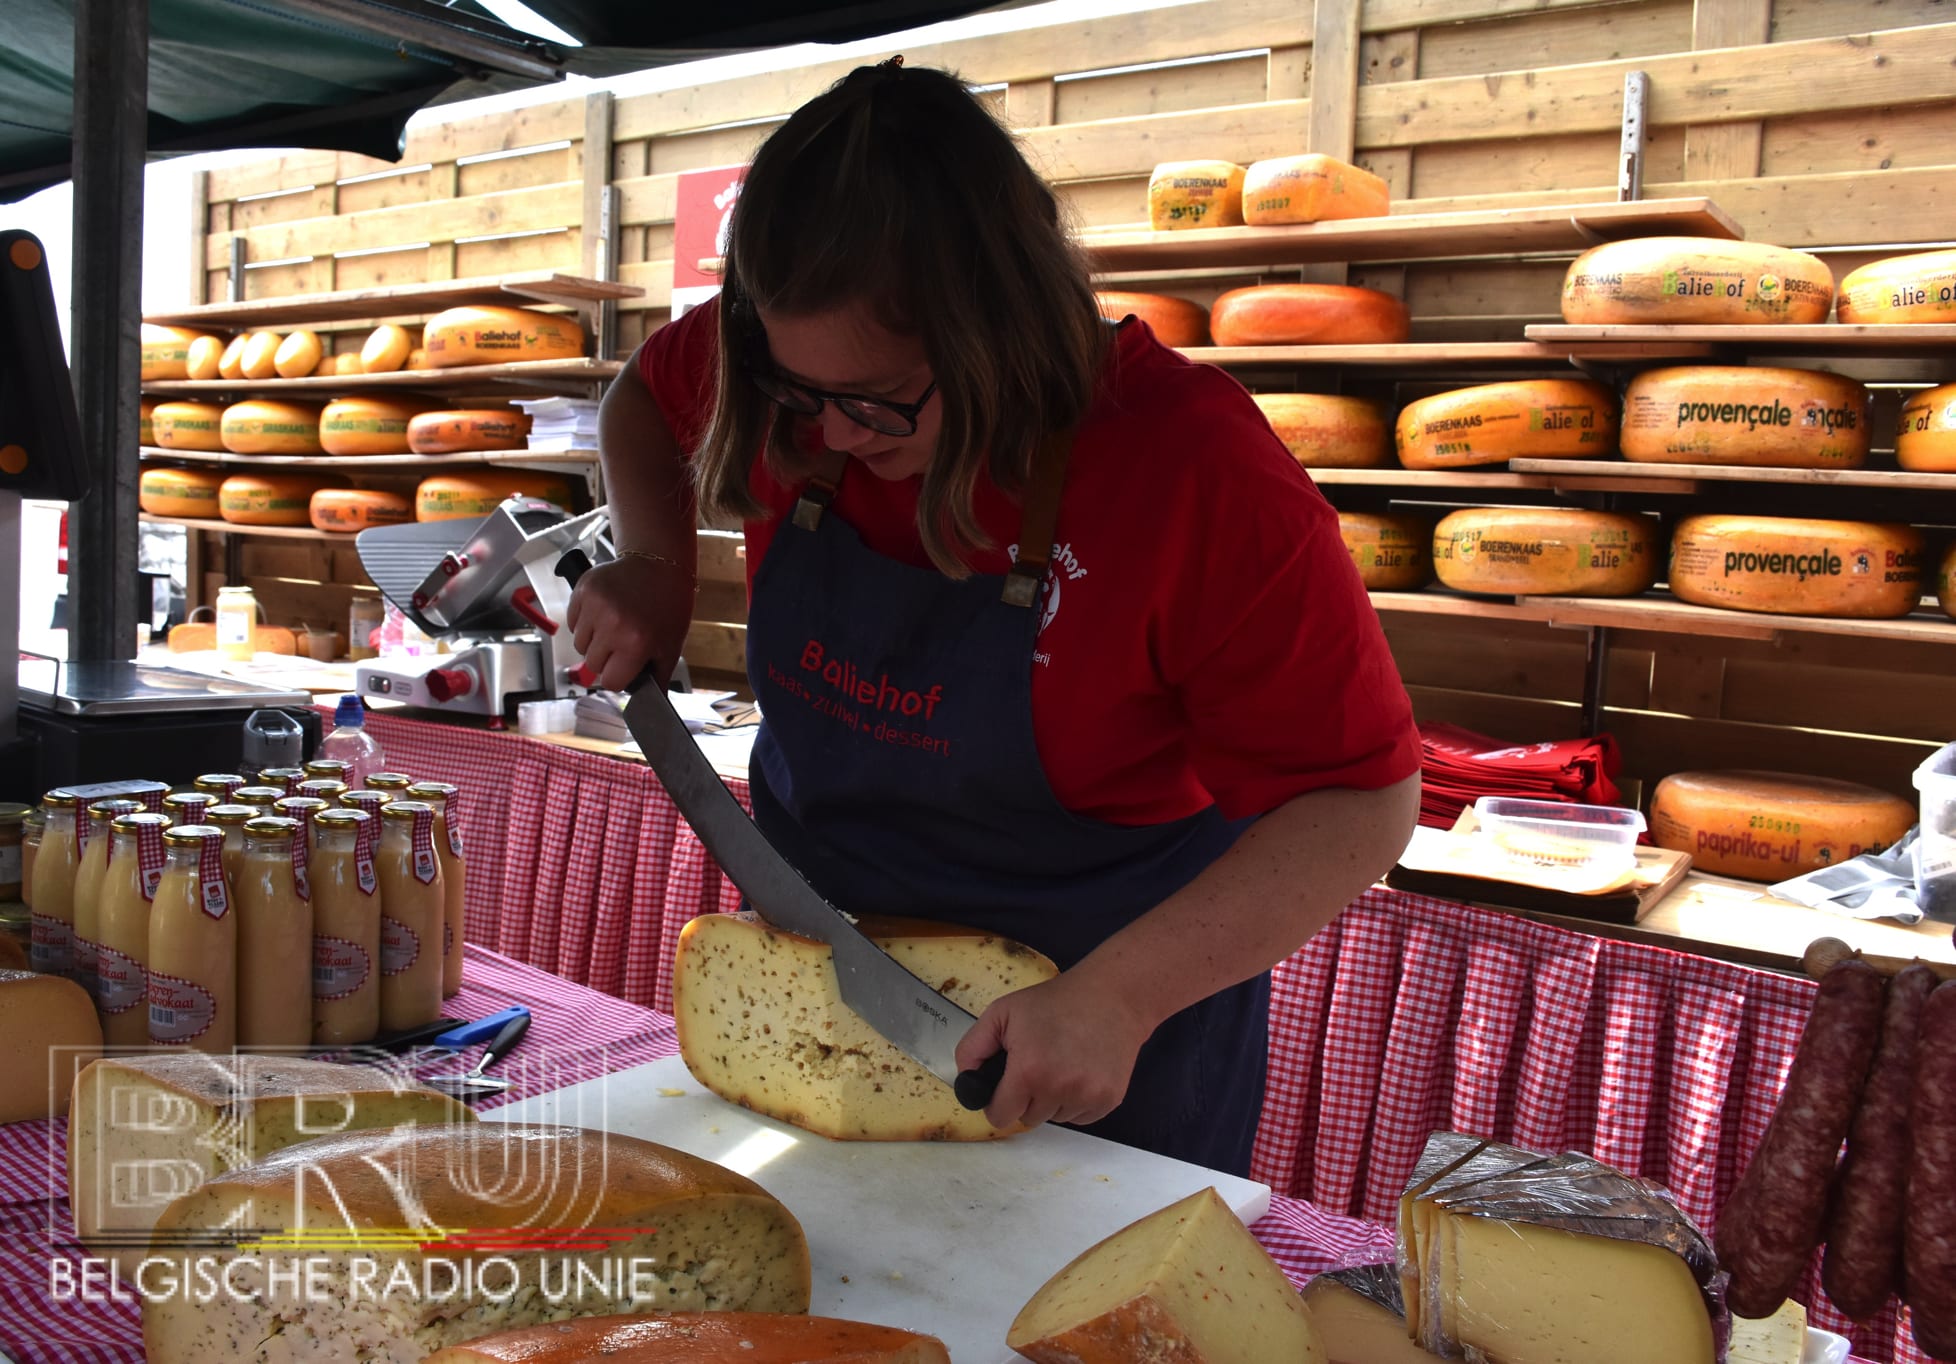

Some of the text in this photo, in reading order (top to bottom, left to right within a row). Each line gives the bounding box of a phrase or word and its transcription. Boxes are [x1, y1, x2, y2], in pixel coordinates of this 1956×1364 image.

[1425, 414, 1483, 435] BOERENKAAS
[1677, 398, 1792, 431] provençale
[1479, 540, 1544, 556] BOERENKAAS
[1724, 548, 1842, 581] provençale
[800, 639, 944, 721] Baliehof
[767, 662, 804, 697] kaas
[873, 721, 950, 757] dessert
